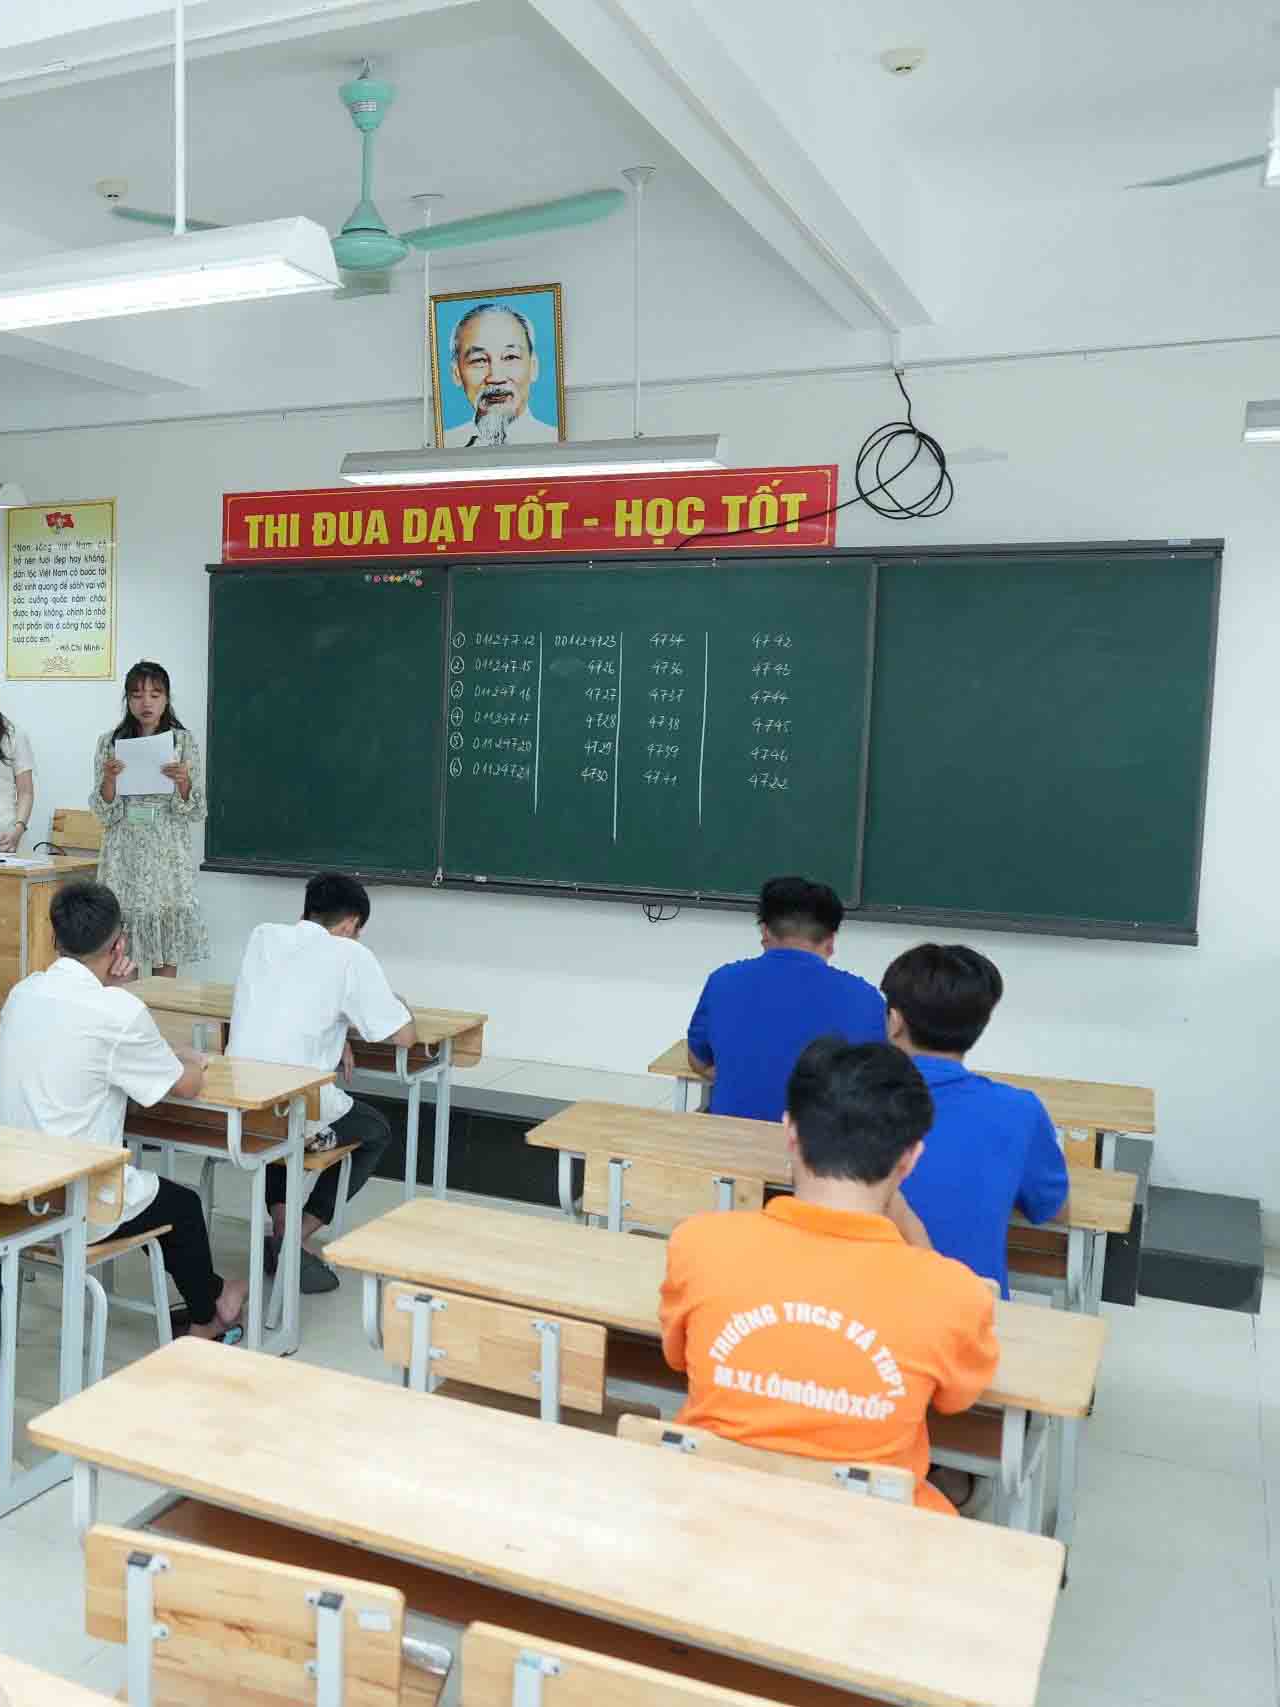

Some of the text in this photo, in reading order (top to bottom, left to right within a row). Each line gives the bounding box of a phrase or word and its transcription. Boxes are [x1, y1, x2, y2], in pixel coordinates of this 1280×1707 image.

[246, 513, 300, 549] THI
[312, 509, 389, 545] ĐUA
[403, 505, 481, 551] DẠY
[494, 489, 569, 541] TỐT
[615, 496, 705, 544] HỌC
[721, 480, 808, 534] TỐT
[53, 567, 68, 577] Nam
[783, 1301, 843, 1331] THCS
